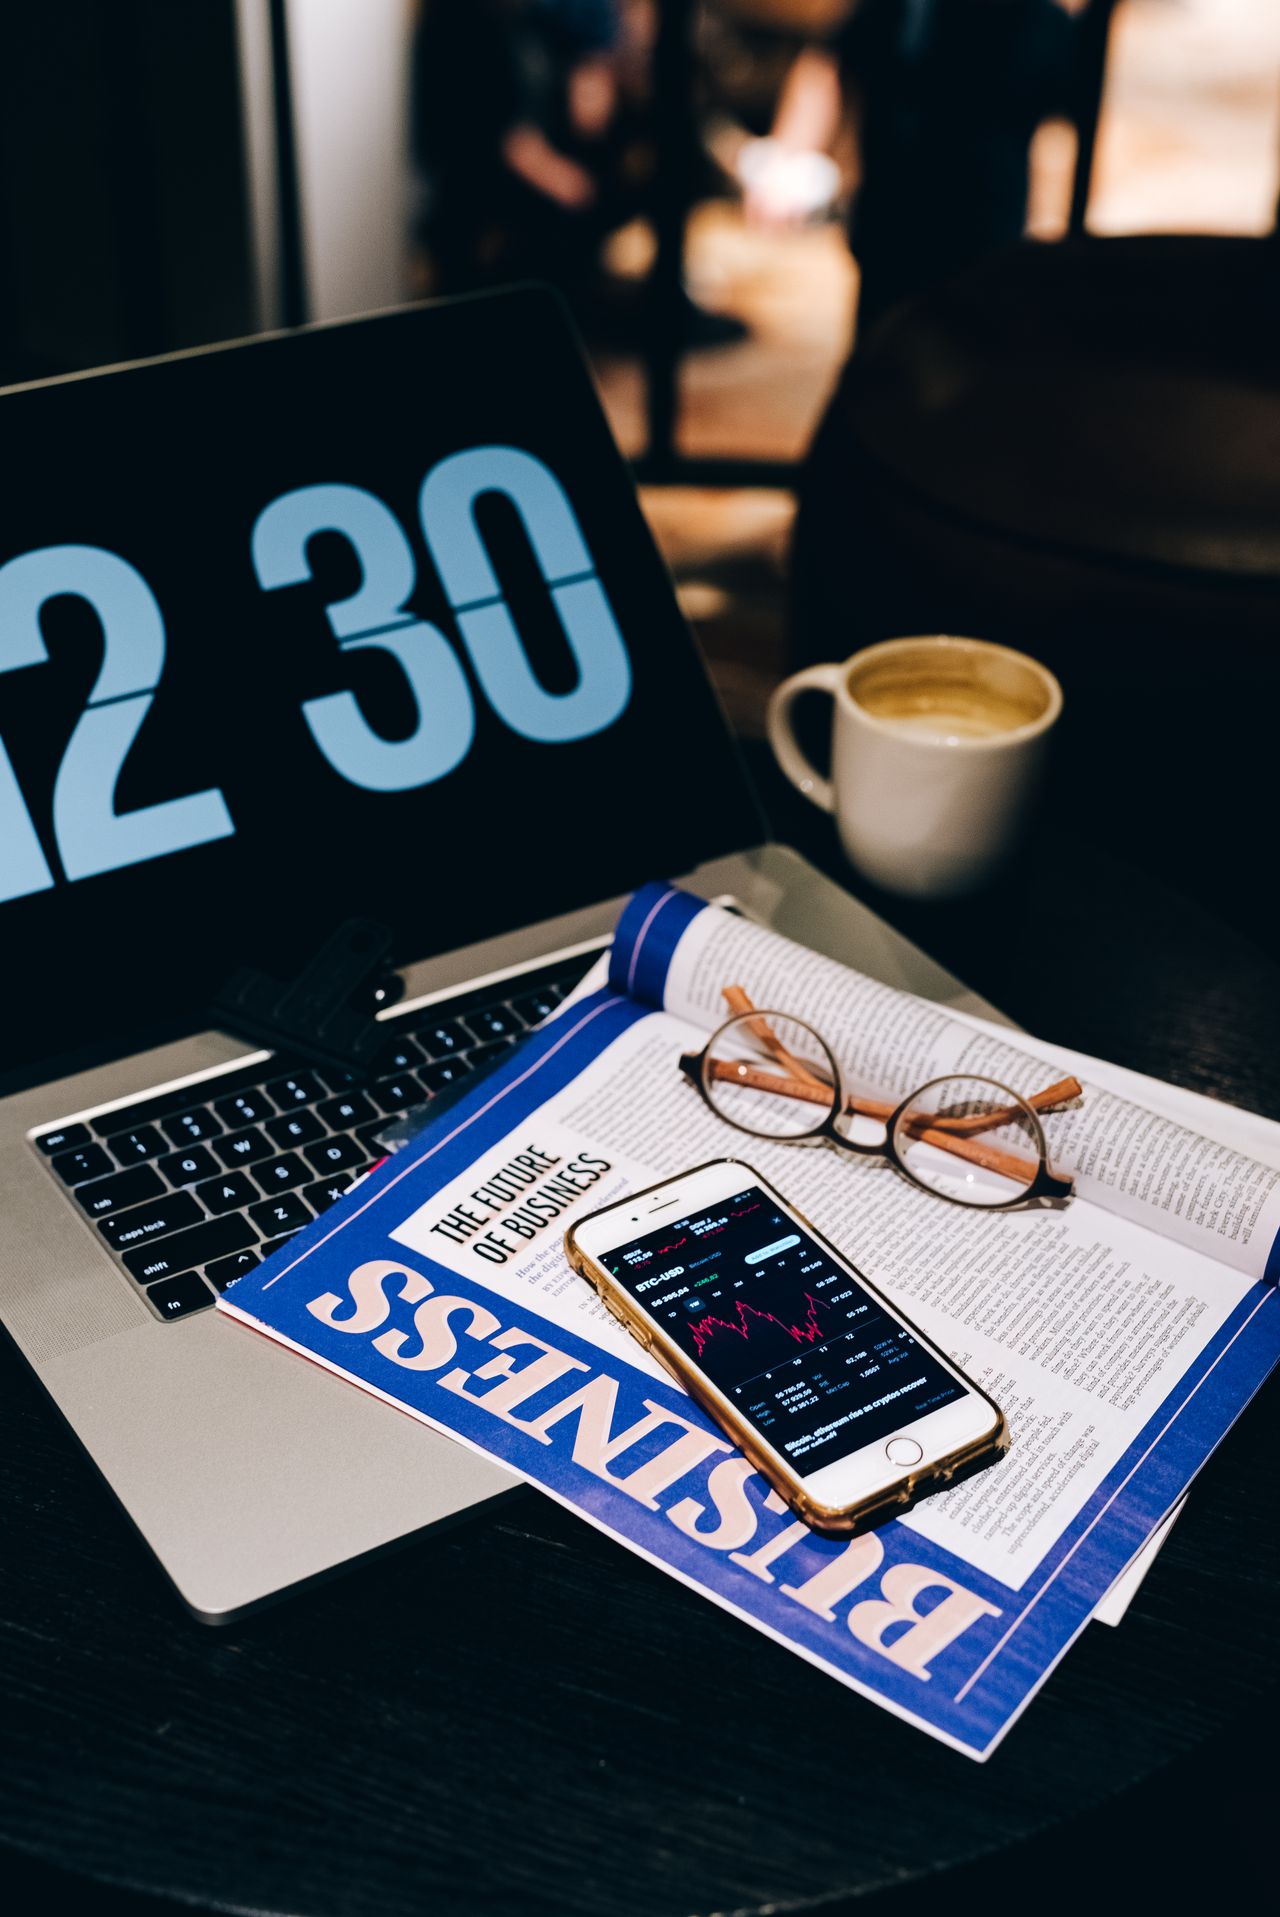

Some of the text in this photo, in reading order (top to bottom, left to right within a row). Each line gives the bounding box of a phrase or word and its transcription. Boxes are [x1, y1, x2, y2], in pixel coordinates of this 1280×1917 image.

[0, 445, 633, 904] 2 30
[233, 1140, 250, 1153] W
[288, 1123, 302, 1134] E
[223, 1187, 236, 1198] A
[274, 1167, 288, 1179] S
[94, 1199, 112, 1209] tab
[274, 1208, 288, 1220] Z
[328, 1188, 343, 1200] X
[428, 1143, 562, 1246] THE FUTURE
[470, 1150, 613, 1266] OF BUSINESS
[119, 1219, 166, 1242] caps lock
[144, 1260, 168, 1275] shift
[514, 1259, 538, 1278] How
[532, 1248, 551, 1262] the
[526, 1271, 543, 1284] the
[633, 1251, 722, 1292] BTC-USD Bitcoin USD
[168, 1300, 180, 1310] fn
[1081, 1375, 1100, 1392] kind
[1102, 1341, 1131, 1371] company
[1128, 1305, 1157, 1335] attractive
[1156, 1282, 1175, 1300] them
[1093, 1297, 1179, 1399] and provides meaning beyond the
[1104, 1294, 1200, 1406] paycheck? Surveys suggest unusually
[1116, 1392, 1138, 1412] large
[1130, 1356, 1167, 1396] percentages
[1164, 1324, 1190, 1351] workers
[1183, 1300, 1211, 1327] globally
[748, 1400, 767, 1412] Open
[811, 1372, 823, 1380] Vol
[997, 1377, 1017, 1394] than
[755, 1408, 772, 1419] High
[762, 1417, 776, 1426] Low
[783, 1376, 929, 1452] Bitcoin, ethereum rise as cryptos recover
[307, 1260, 1003, 1681] BUSINESS
[790, 1444, 812, 1457] after
[932, 1395, 1035, 1513] speed; that
[944, 1412, 1039, 1519] enabled remote and work;
[955, 1509, 974, 1526] and
[967, 1482, 999, 1513] keeping
[989, 1456, 1018, 1485] millions
[1018, 1426, 1045, 1451] people
[1036, 1413, 1055, 1429] fed,
[967, 1502, 999, 1534] clothed,
[990, 1464, 1028, 1505] entertained
[1021, 1450, 1039, 1467] and
[1038, 1424, 1061, 1446] touch
[1053, 1409, 1073, 1427] with
[999, 1520, 1018, 1537] The
[1013, 1501, 1036, 1524] scope
[1026, 1486, 1044, 1503] and
[1037, 1466, 1063, 1491] speed
[1060, 1435, 1087, 1462] change
[1080, 1424, 1096, 1438] was
[979, 1449, 1058, 1542] ramped-up digital services.
[1003, 1438, 1102, 1556] unprecedented, accelerating digital
